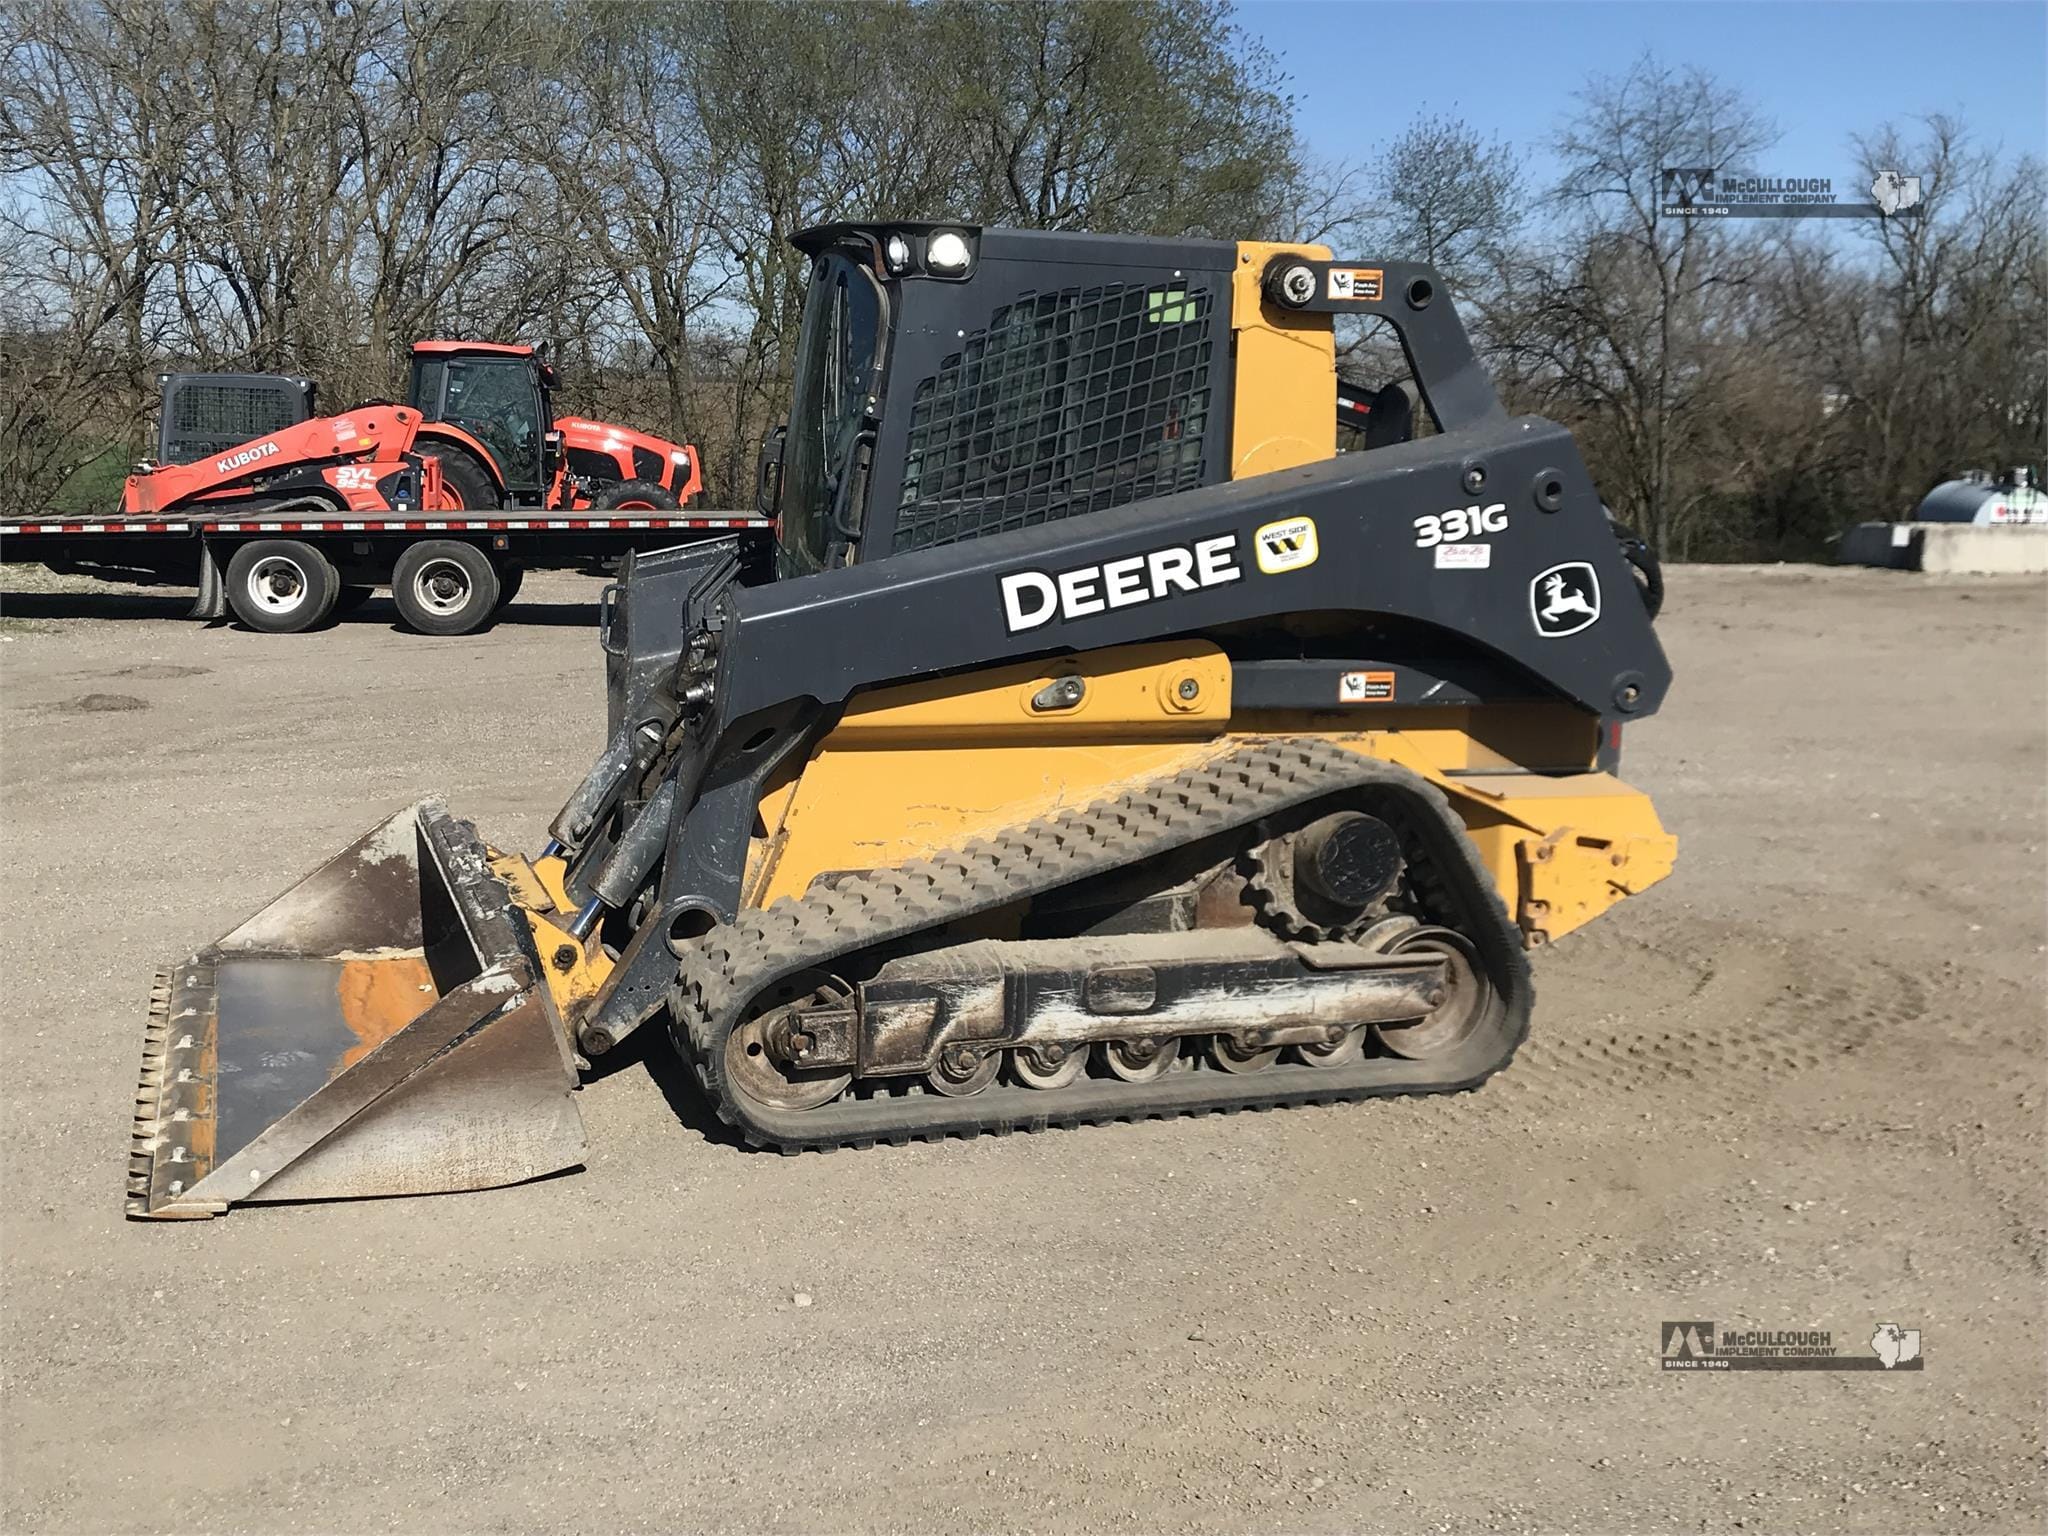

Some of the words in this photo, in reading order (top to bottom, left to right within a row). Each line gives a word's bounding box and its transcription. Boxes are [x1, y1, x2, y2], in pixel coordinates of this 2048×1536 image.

[571, 421, 601, 432] KUBOTA
[216, 441, 280, 473] KUBOTA
[336, 466, 377, 481] SVL
[1262, 529, 1287, 541] WEST
[1288, 525, 1309, 535] SIDE
[1413, 503, 1509, 548] 331G
[1001, 535, 1241, 632] DEERE
